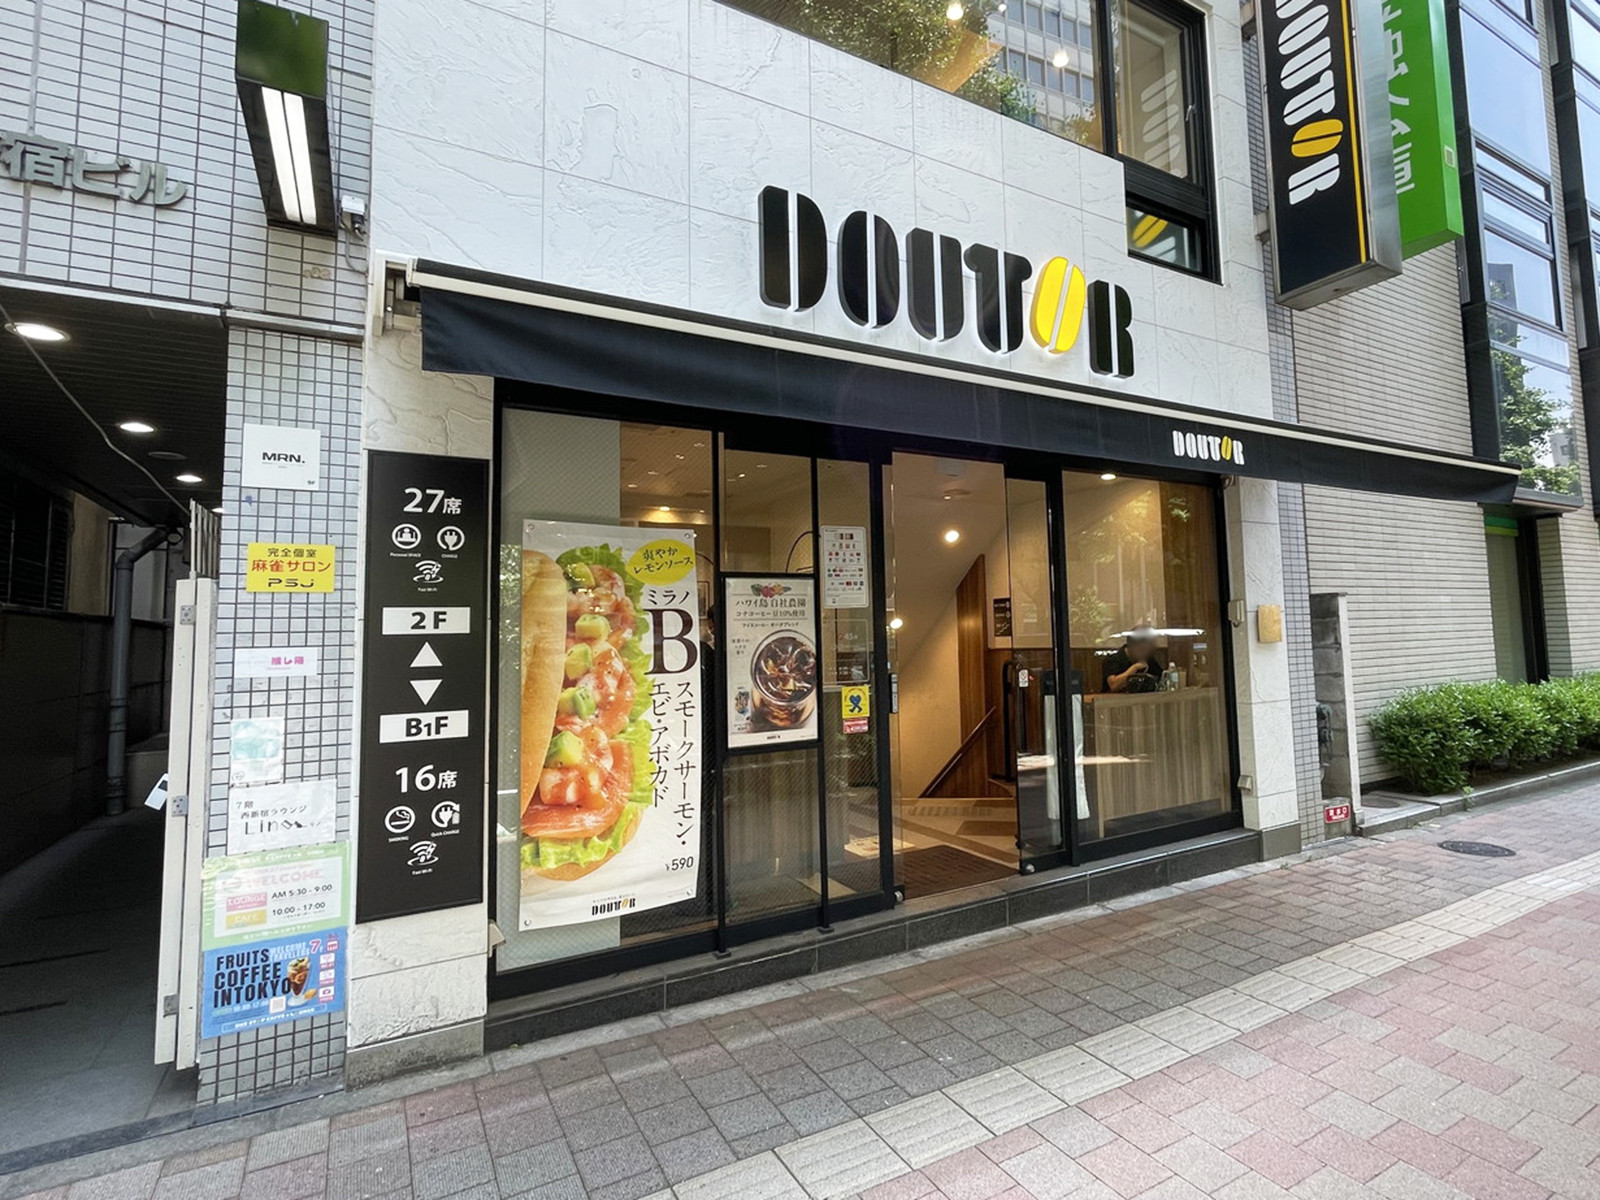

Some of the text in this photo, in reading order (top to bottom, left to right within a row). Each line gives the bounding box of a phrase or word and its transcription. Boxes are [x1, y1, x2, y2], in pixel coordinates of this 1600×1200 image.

[0, 131, 188, 207] 宿ビル
[758, 185, 1135, 379] DOUTOR
[262, 452, 305, 464] MRN.
[1172, 430, 1245, 465] DOUTOR
[403, 487, 462, 515] 27席
[267, 547, 317, 558] 完全個室
[642, 546, 678, 563] 爽やか
[251, 559, 331, 573] 麻雀サロン
[633, 556, 694, 576] レモンソース
[647, 589, 690, 606] ミラノ
[410, 611, 447, 630] 2F
[643, 608, 698, 675] B
[405, 716, 448, 737] B1F
[648, 683, 671, 808] エビ・アボカド
[395, 764, 458, 793] 16席
[271, 891, 287, 899] AM
[592, 898, 636, 916] DOUTOR
[216, 948, 269, 971] FRUITS
[214, 962, 281, 990] COFFEE
[213, 977, 291, 1008] INTOKYO
